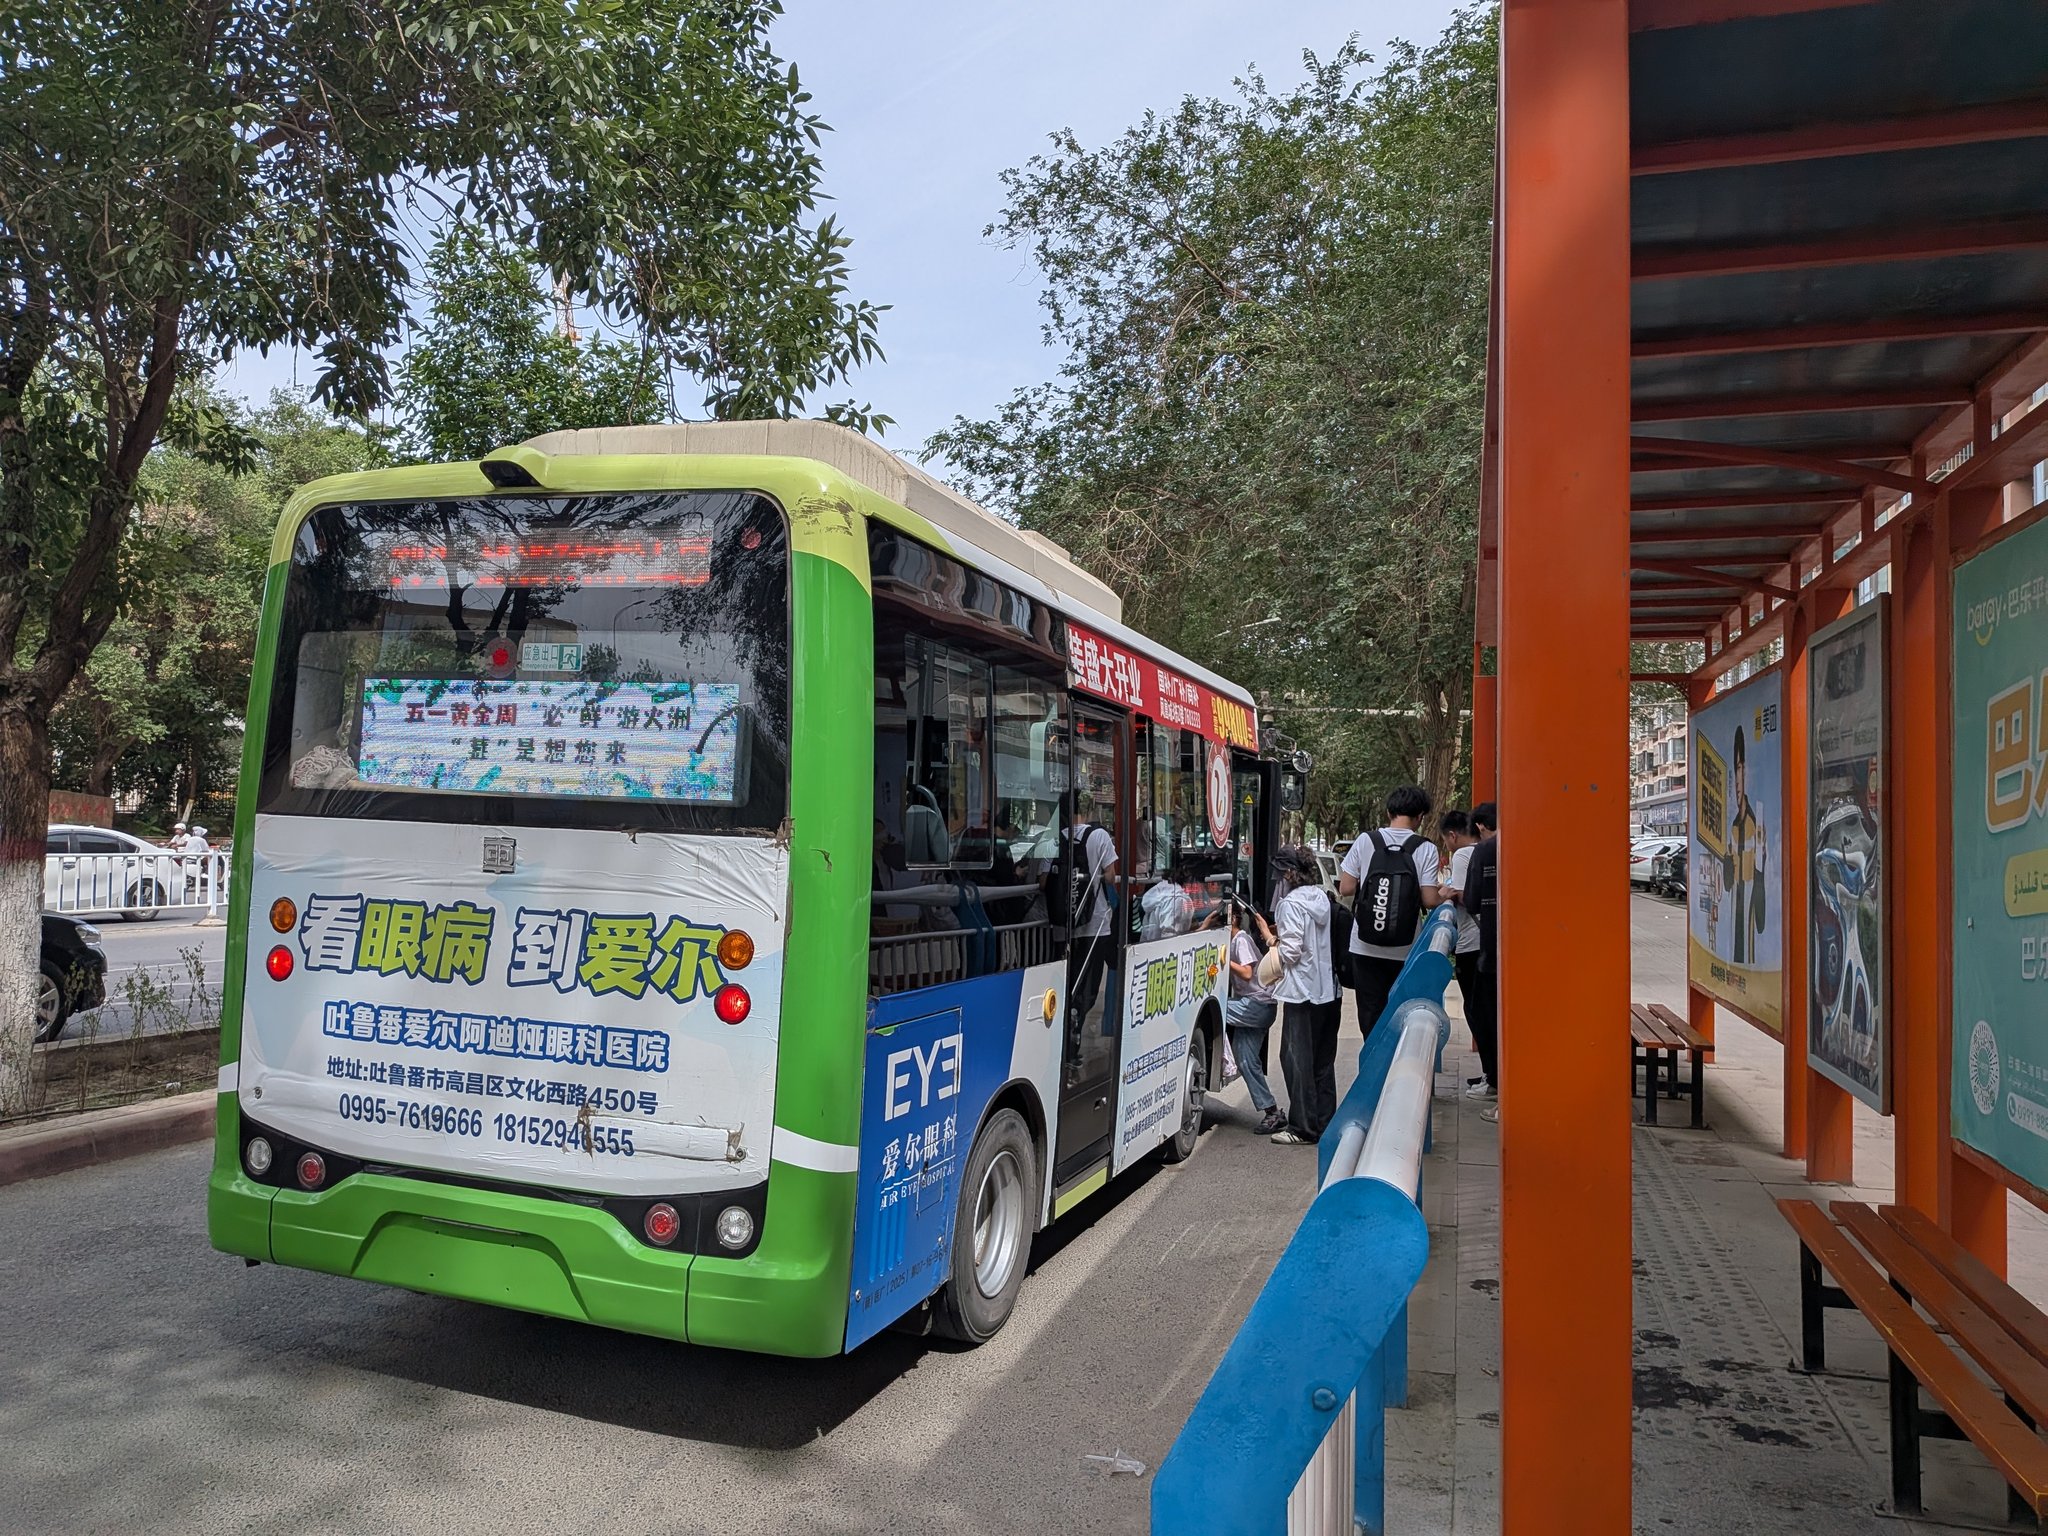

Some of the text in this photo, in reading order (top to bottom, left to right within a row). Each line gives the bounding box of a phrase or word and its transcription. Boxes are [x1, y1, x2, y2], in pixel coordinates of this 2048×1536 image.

[523, 644, 559, 660] 应急出口
[404, 701, 517, 726] 五一黄金周
[1763, 704, 1777, 735] 美团
[1373, 877, 1390, 932] adidas
[299, 892, 730, 1005] 看眼病 到爱尔
[1130, 944, 1220, 1030] 看眼病 到爱尔
[322, 999, 671, 1073] 吐鲁番爱尔阿迪娅眼科医院
[338, 1092, 483, 1138] 0995-7619666
[881, 1113, 958, 1184] 爱尔眼科
